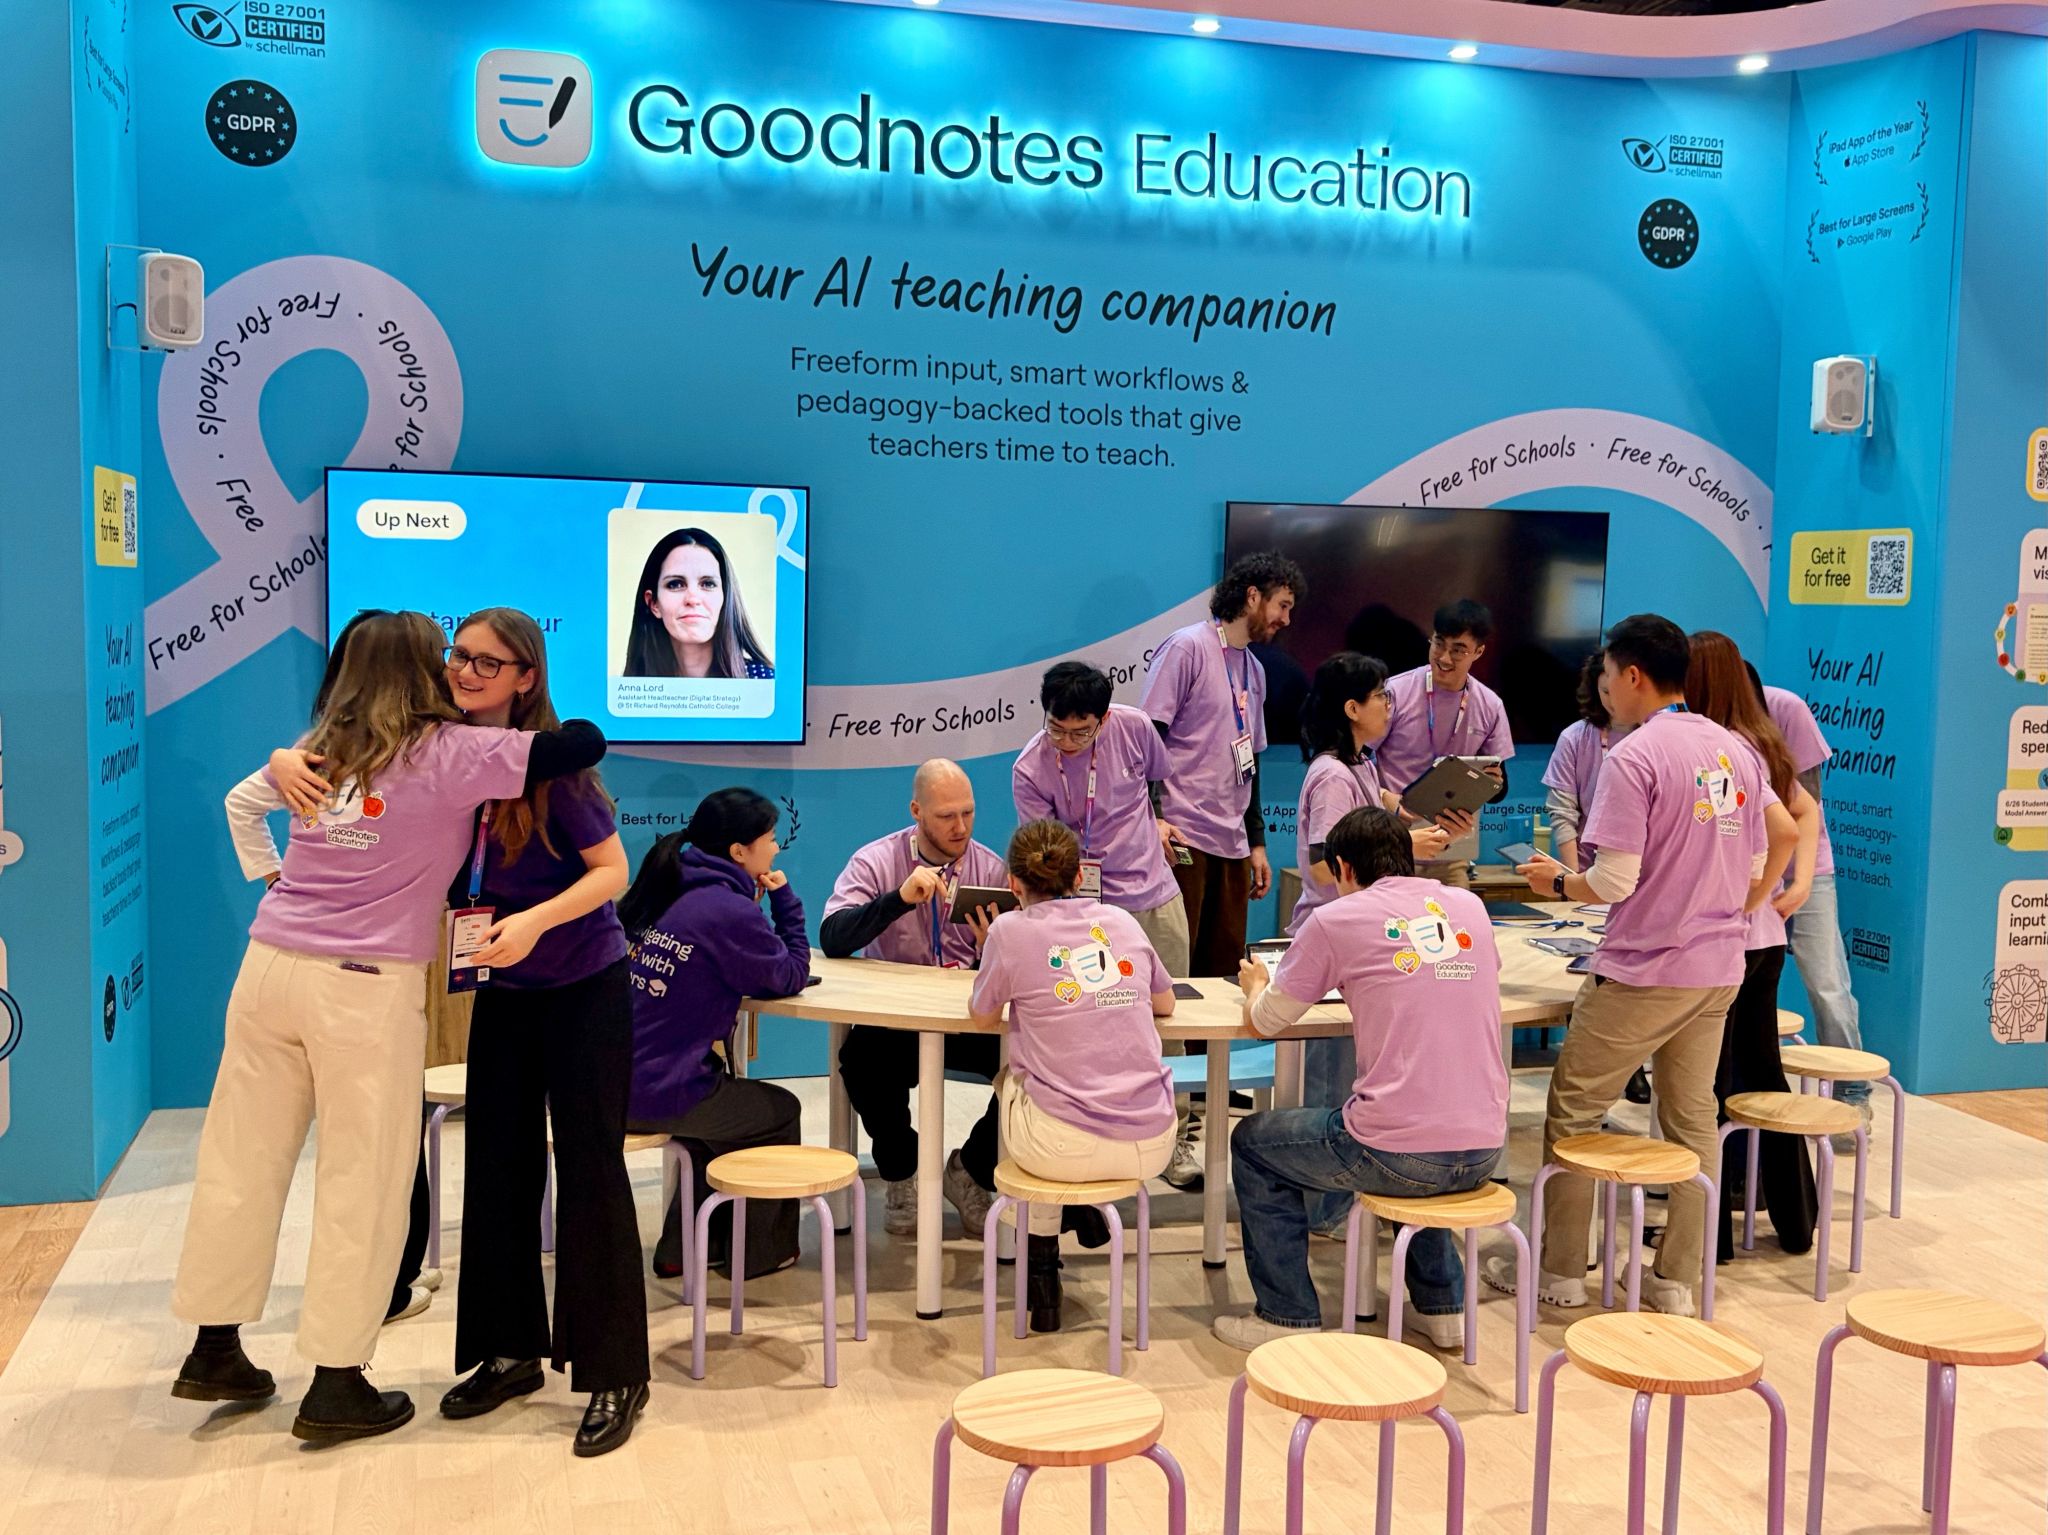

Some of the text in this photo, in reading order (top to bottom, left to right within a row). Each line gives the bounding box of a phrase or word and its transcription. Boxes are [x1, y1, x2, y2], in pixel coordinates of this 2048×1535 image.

[245, 0, 325, 20] ISO 27001
[248, 19, 322, 40] CERTIFIED
[256, 40, 325, 58] schellman
[227, 113, 276, 134] GDPR
[1670, 134, 1723, 149] ISO 27001
[1829, 120, 1914, 154] iPad App of the Year
[628, 84, 1471, 218] Goodnotes Education
[1671, 149, 1721, 166] CERTIFIED
[1852, 145, 1895, 167] App Store
[1675, 166, 1722, 179] schellman
[1819, 202, 1915, 235] Best for Large Screens
[1652, 225, 1685, 242] GDPR
[1846, 227, 1892, 247] Google Play
[691, 243, 1337, 343] Your AI teaching companion
[196, 291, 340, 436] Free for Schools
[791, 347, 1249, 393] Freeform input, smart workflows &
[378, 320, 428, 459] for Schools
[797, 390, 1242, 436] pedagogy-backed tools that give
[868, 433, 1176, 468] teachers time to teach.
[1419, 434, 1751, 523] Free for Schools Free for Schools
[216, 478, 264, 532] Free
[374, 511, 450, 530] Up Next
[1811, 547, 1846, 565] Get it
[1804, 569, 1851, 587] for free
[148, 624, 206, 670] Free
[209, 596, 246, 632] for
[1809, 647, 1884, 687] Your AI
[617, 684, 664, 692] Anna Lord
[1106, 666, 1137, 691] for
[647, 694, 688, 702] Headteacher
[829, 698, 1015, 739] Free for Schools
[1821, 745, 1896, 781] panion
[621, 812, 653, 825] Best
[656, 812, 678, 825] for
[1273, 805, 1297, 818] App
[1483, 803, 1549, 817] Large Scree
[1831, 799, 1859, 816] input,
[1862, 803, 1893, 819] smart
[328, 825, 378, 843] Goodnotes
[328, 833, 367, 849] Education
[1830, 818, 1836, 832] &
[1839, 822, 1897, 845] pedagogy-
[1832, 841, 1892, 866] ols that give
[1848, 866, 1858, 881] to
[2009, 913, 2046, 931] input
[2009, 931, 2048, 947] learni
[641, 952, 675, 977] with
[1436, 962, 1476, 971] Goodnotes
[1437, 970, 1471, 978] Education
[1096, 989, 1138, 999] Goodnotes
[1097, 998, 1132, 1007] Education
